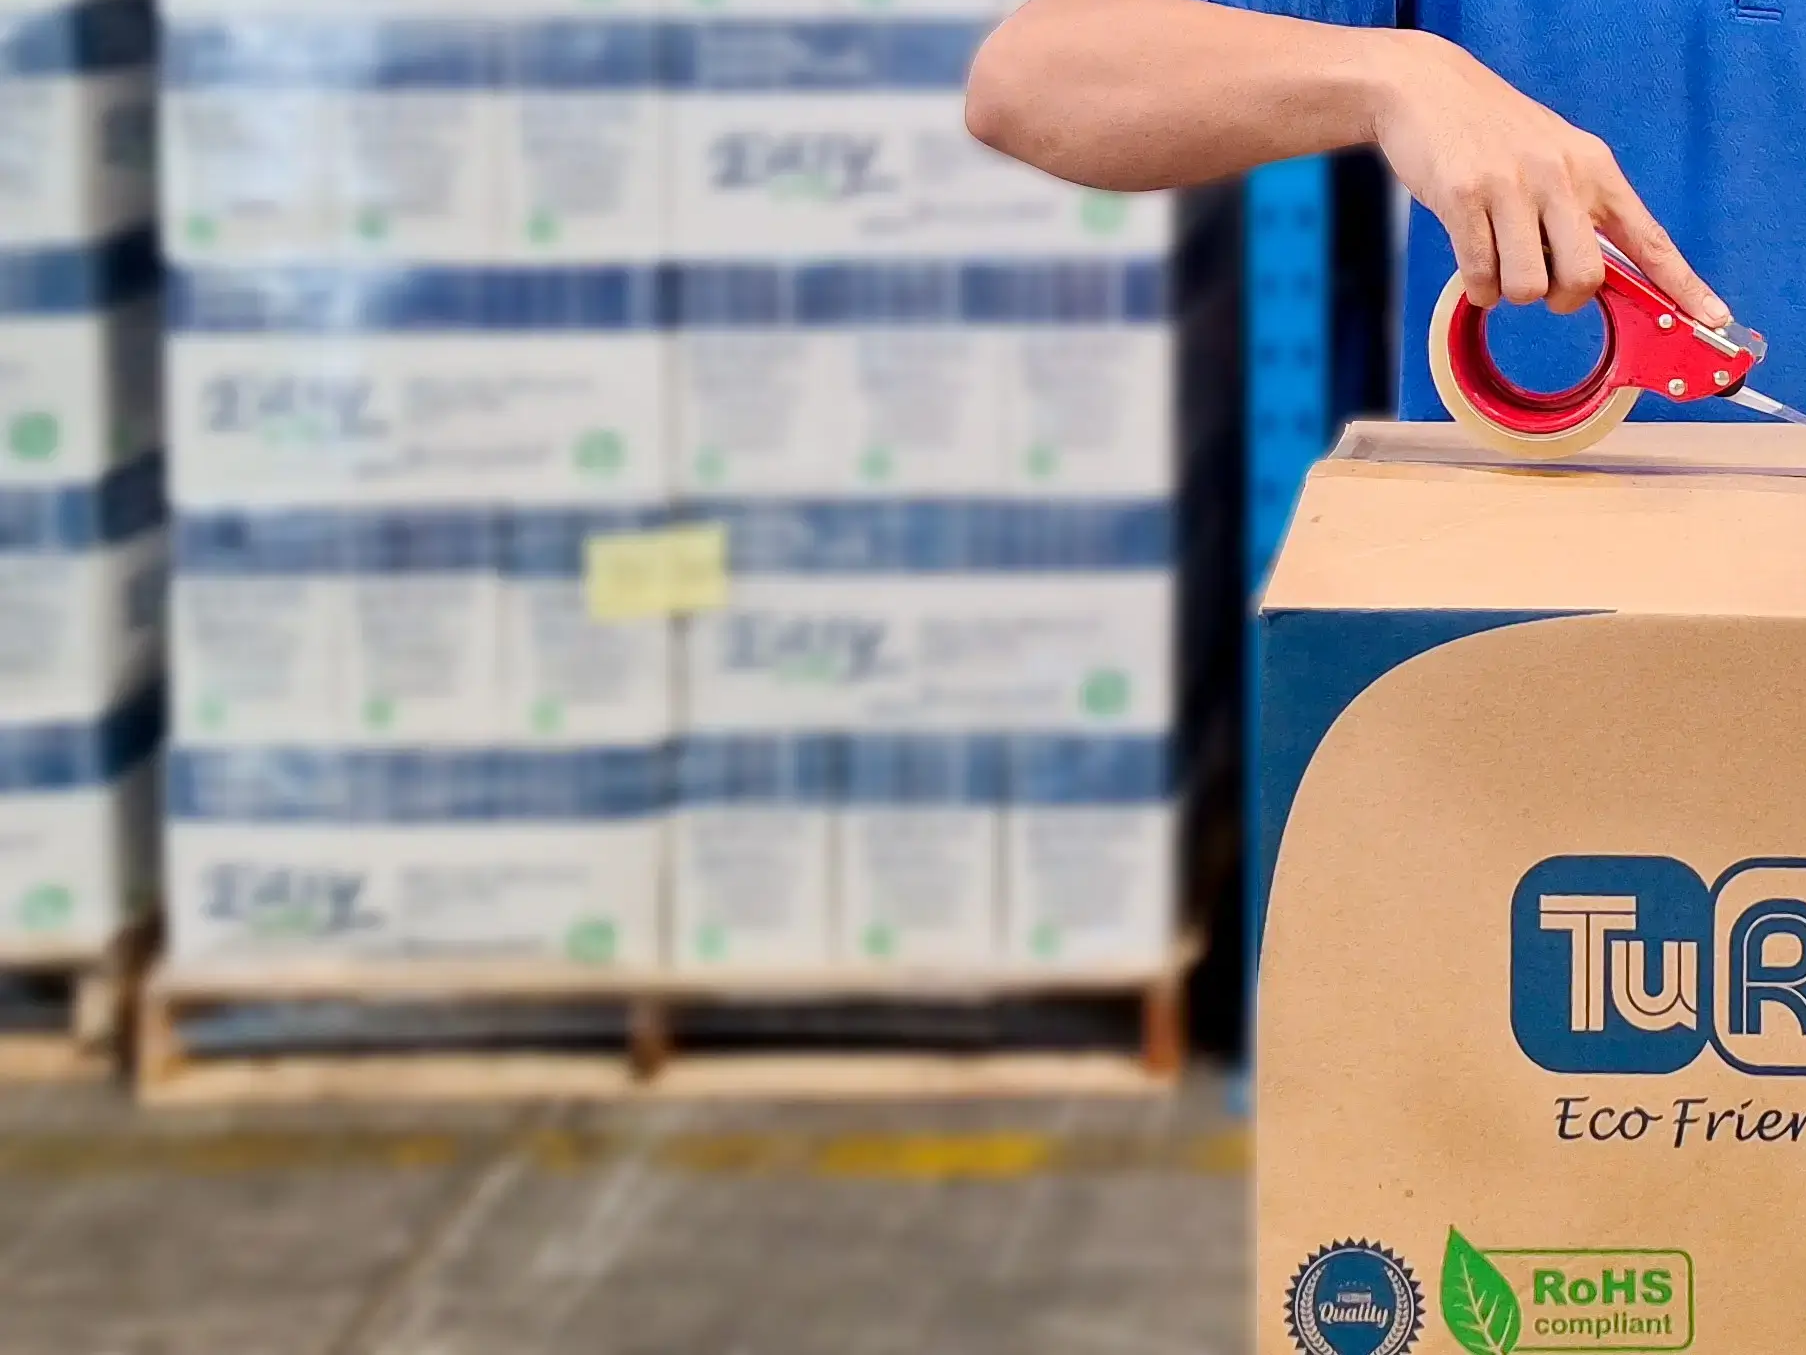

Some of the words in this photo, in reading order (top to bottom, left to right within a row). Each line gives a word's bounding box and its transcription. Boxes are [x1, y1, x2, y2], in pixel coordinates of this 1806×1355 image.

[1554, 1096, 1662, 1141] Eco
[1533, 1268, 1673, 1306] RoHS
[1318, 1301, 1389, 1329] Quality
[1534, 1313, 1673, 1338] compliant
